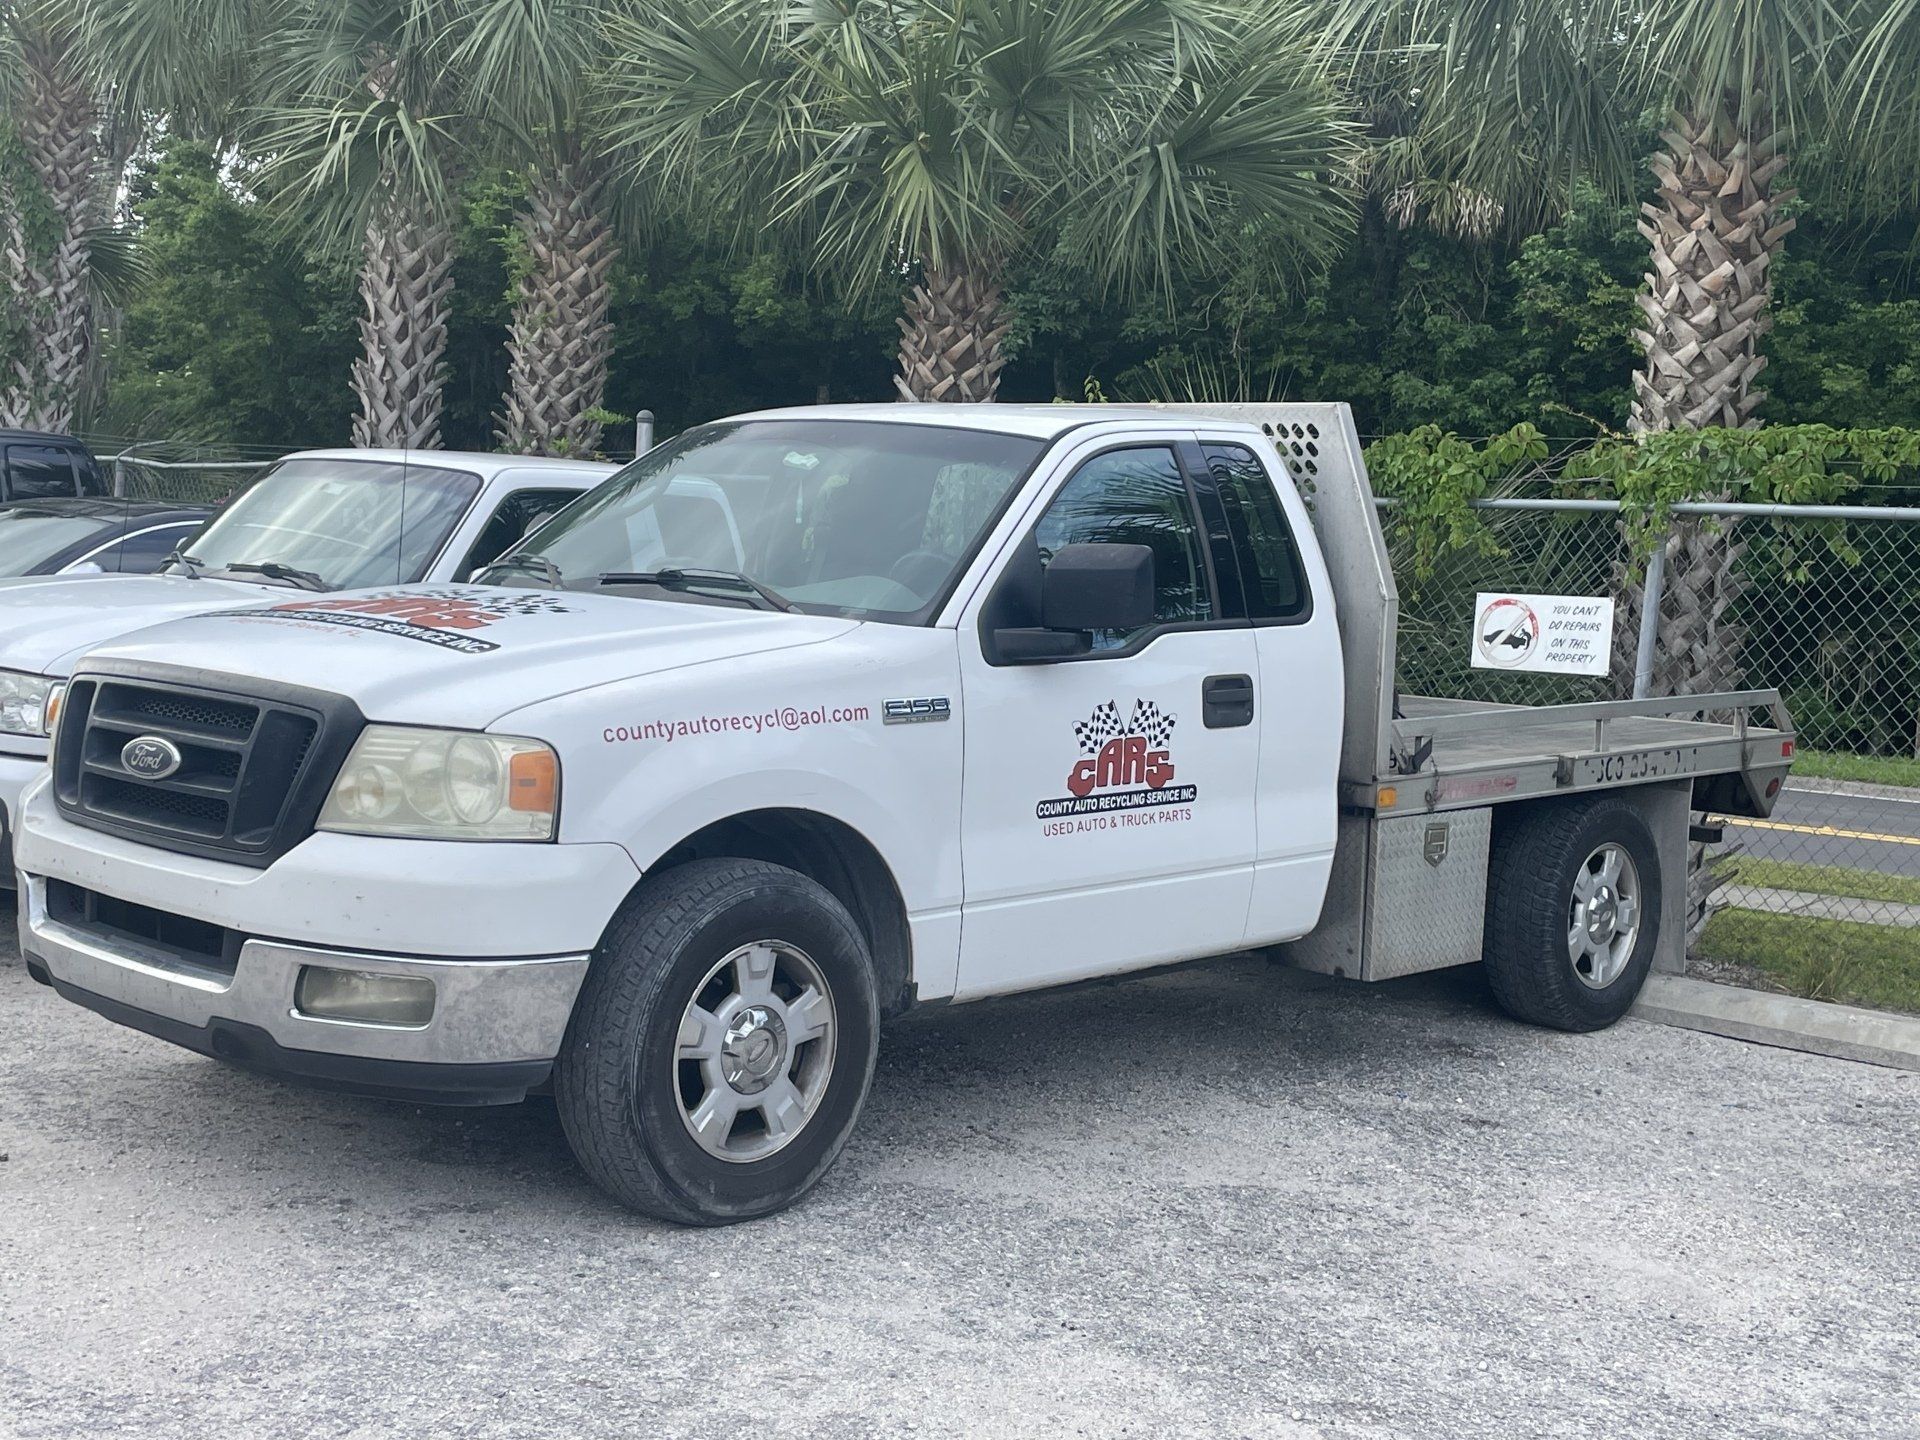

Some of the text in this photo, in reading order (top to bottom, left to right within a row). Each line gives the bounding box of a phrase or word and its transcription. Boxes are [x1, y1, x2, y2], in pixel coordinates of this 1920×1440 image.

[1552, 605, 1571, 614] YOU
[375, 622, 458, 644] SERVICE
[1548, 620, 1601, 632] DO REPAIRS
[1550, 638, 1590, 650] ON THIS
[1545, 652, 1597, 664] PROPERTY
[603, 705, 869, 742] countyautorecycl@aol.com
[131, 744, 164, 769] Ford
[1067, 736, 1175, 798] CARS
[1037, 787, 1196, 817] COUNTY AUTO RECYCLING SERVICE INC.
[1043, 808, 1192, 837] USED AUTO & TRUCK PARTS
